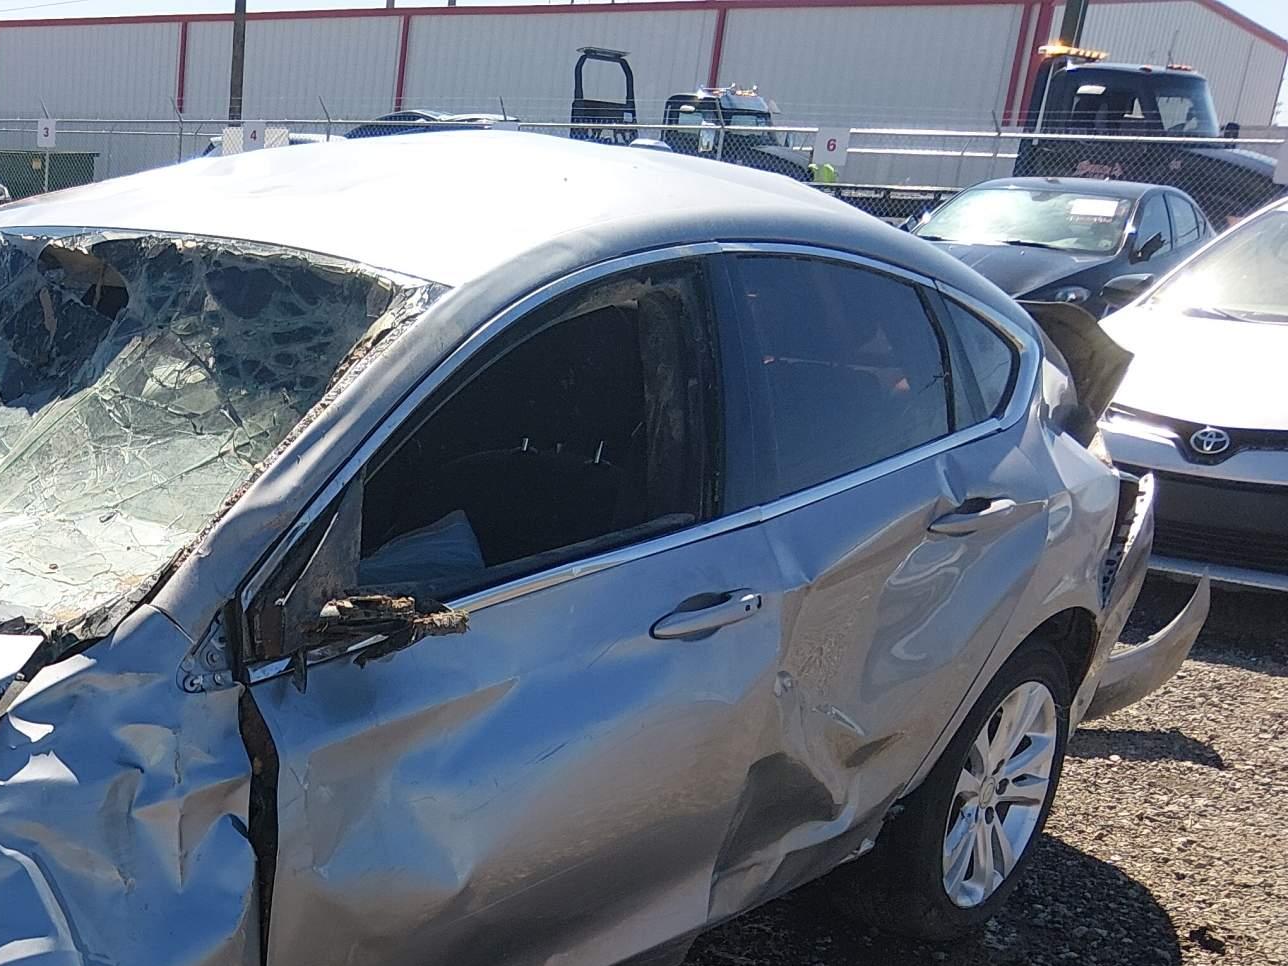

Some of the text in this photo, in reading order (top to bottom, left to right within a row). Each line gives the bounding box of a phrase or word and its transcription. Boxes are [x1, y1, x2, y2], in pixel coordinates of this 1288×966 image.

[43, 127, 49, 137] 3
[250, 130, 257, 141] 4
[827, 138, 837, 152] 6
